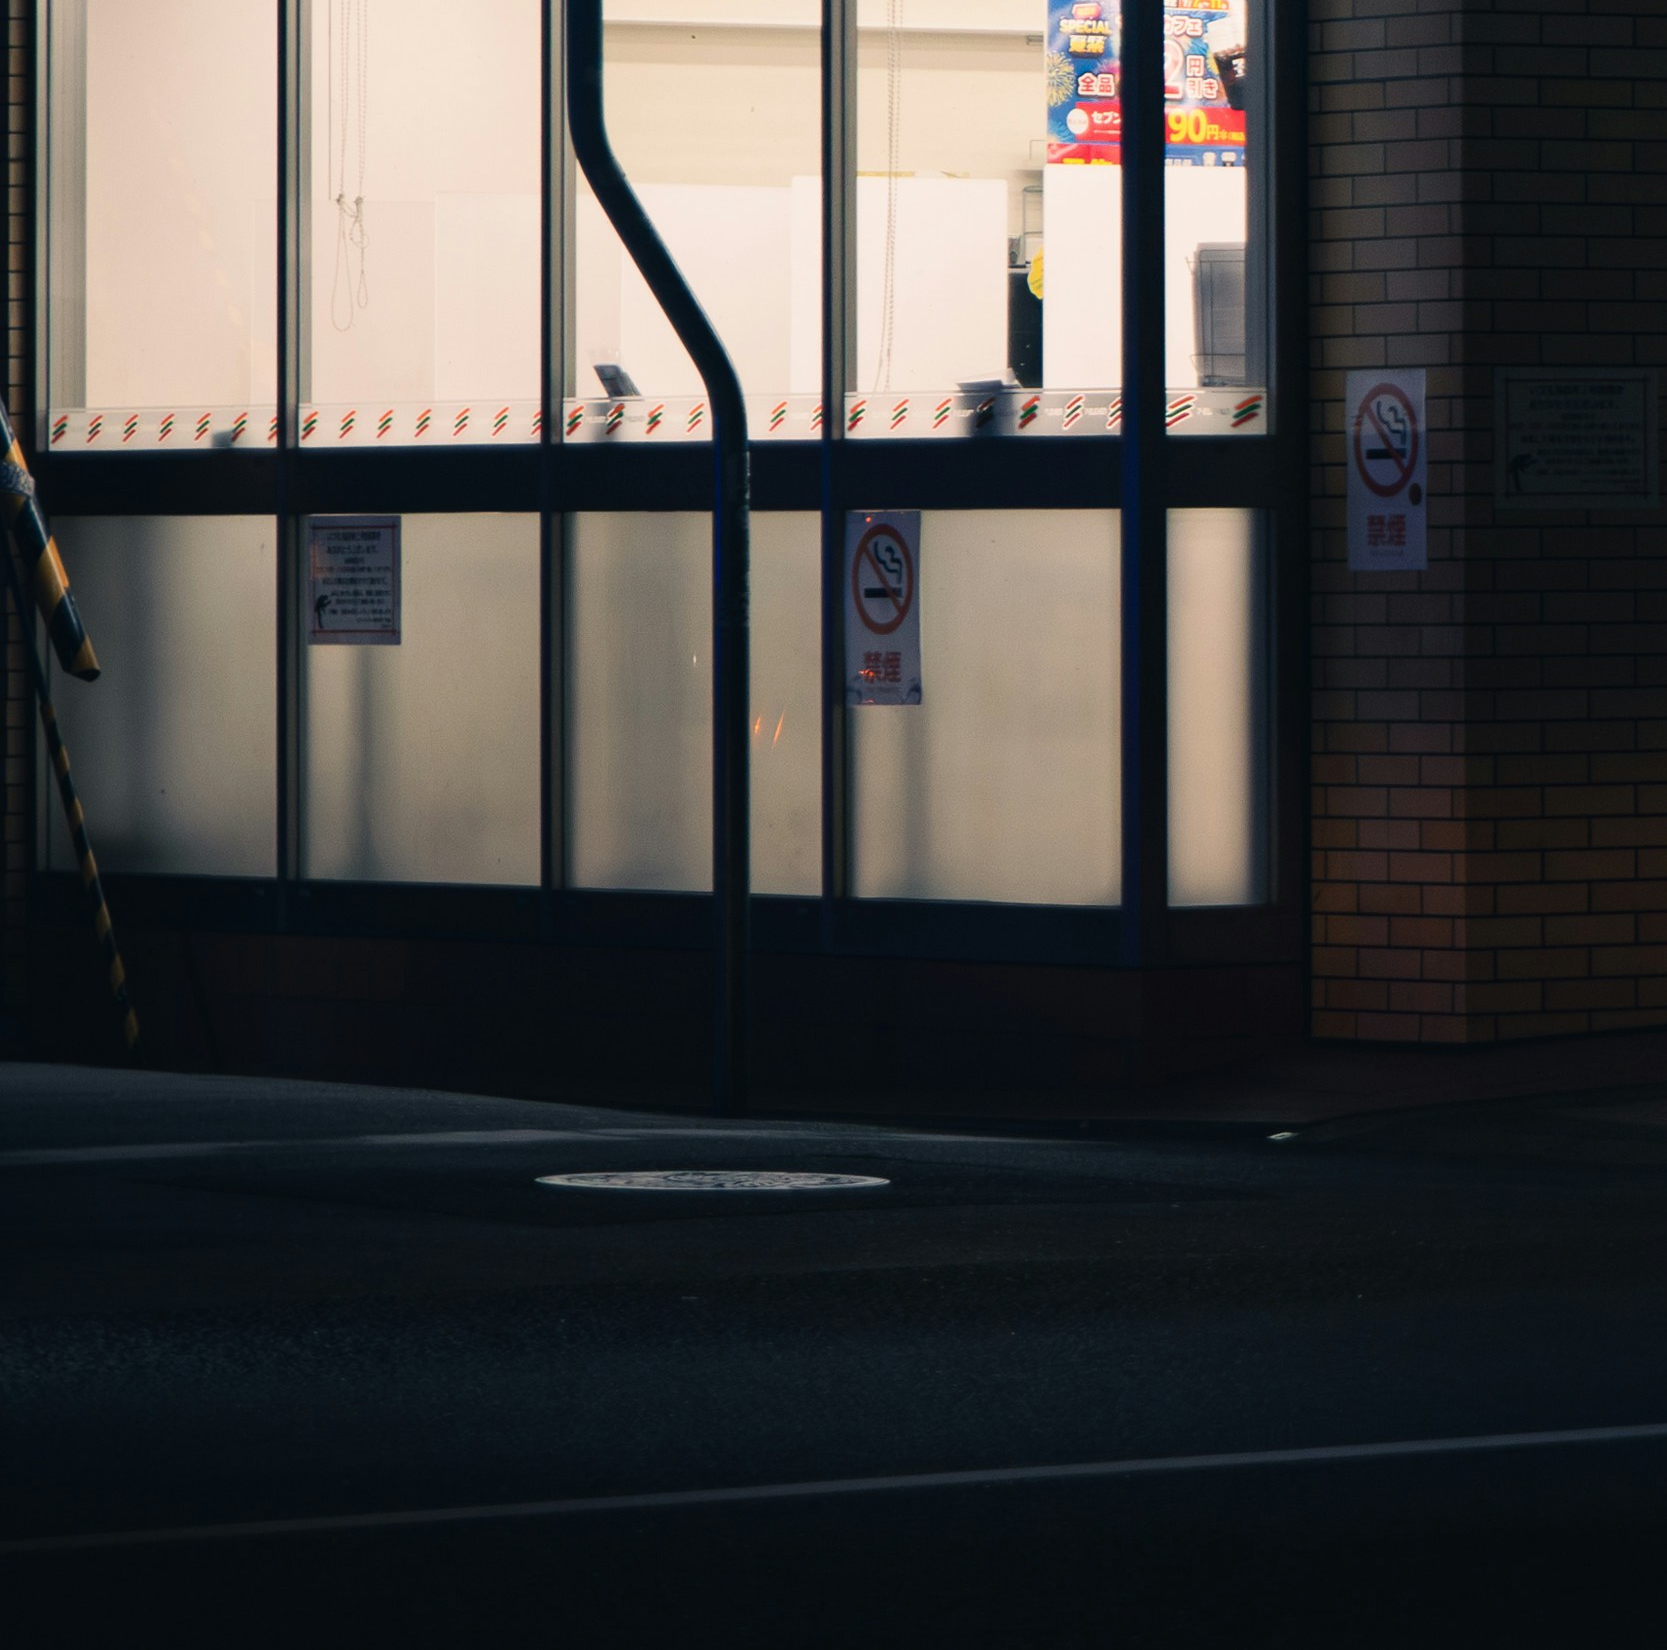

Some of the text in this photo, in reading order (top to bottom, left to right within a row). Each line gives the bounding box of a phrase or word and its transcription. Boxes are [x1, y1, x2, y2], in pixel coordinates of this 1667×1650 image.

[1060, 19, 1112, 34] SPECIAL
[1079, 73, 1115, 96] 全品
[1367, 514, 1407, 547] 禁煙
